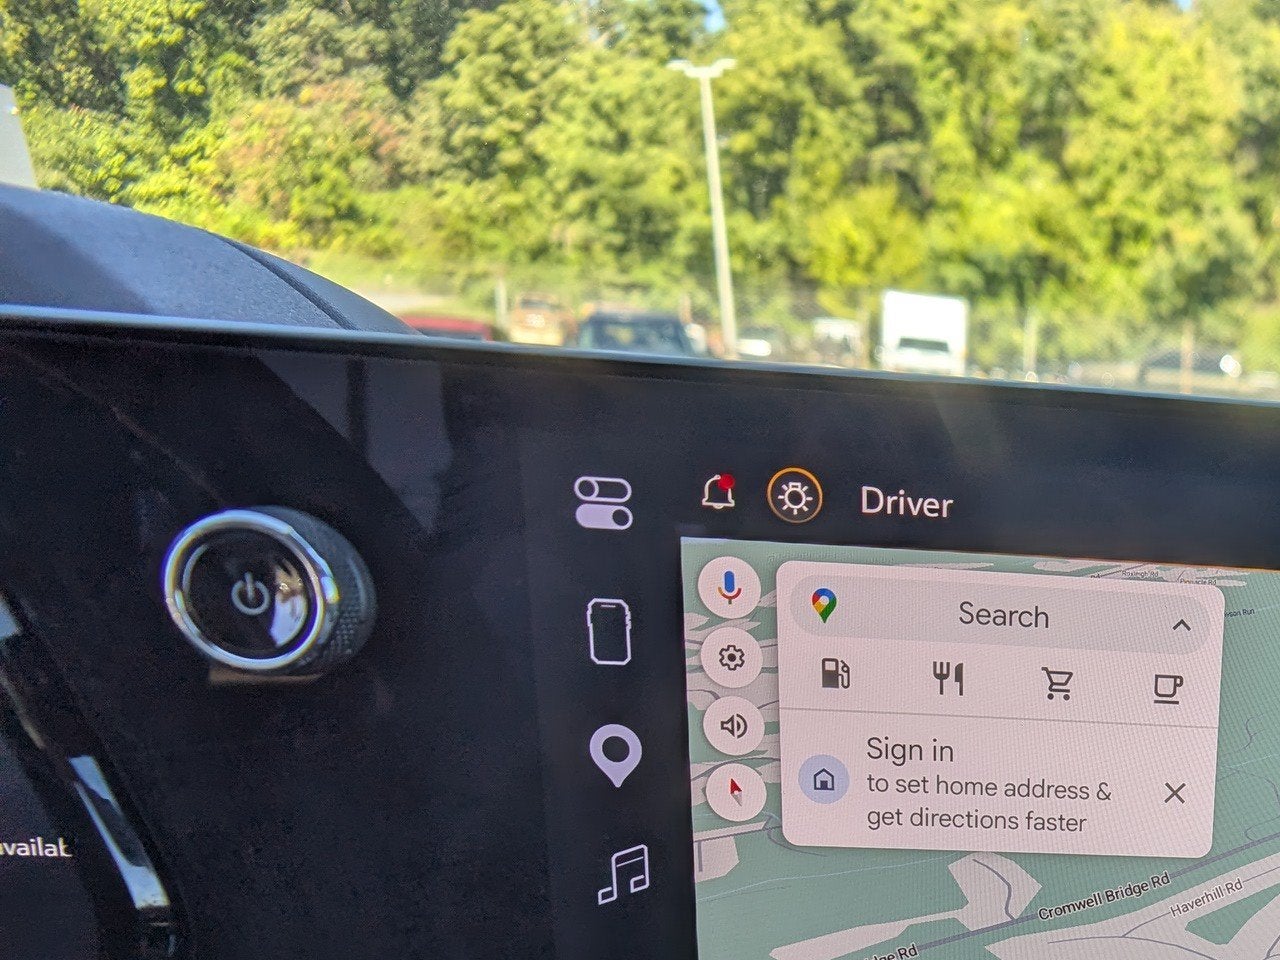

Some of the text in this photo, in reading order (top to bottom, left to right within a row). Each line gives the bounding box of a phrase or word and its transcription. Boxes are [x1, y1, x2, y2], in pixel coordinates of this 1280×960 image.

[861, 486, 954, 519] Driver
[958, 601, 1050, 630] Search
[1242, 608, 1255, 616] Run
[867, 737, 954, 765] Sign in
[867, 775, 1112, 801] to set home address &
[867, 807, 1088, 833] get directions faster
[1039, 872, 1171, 920] Cromwell Bridge Rd
[1169, 878, 1243, 917] Haverhill Rd
[898, 944, 919, 960] Rd
